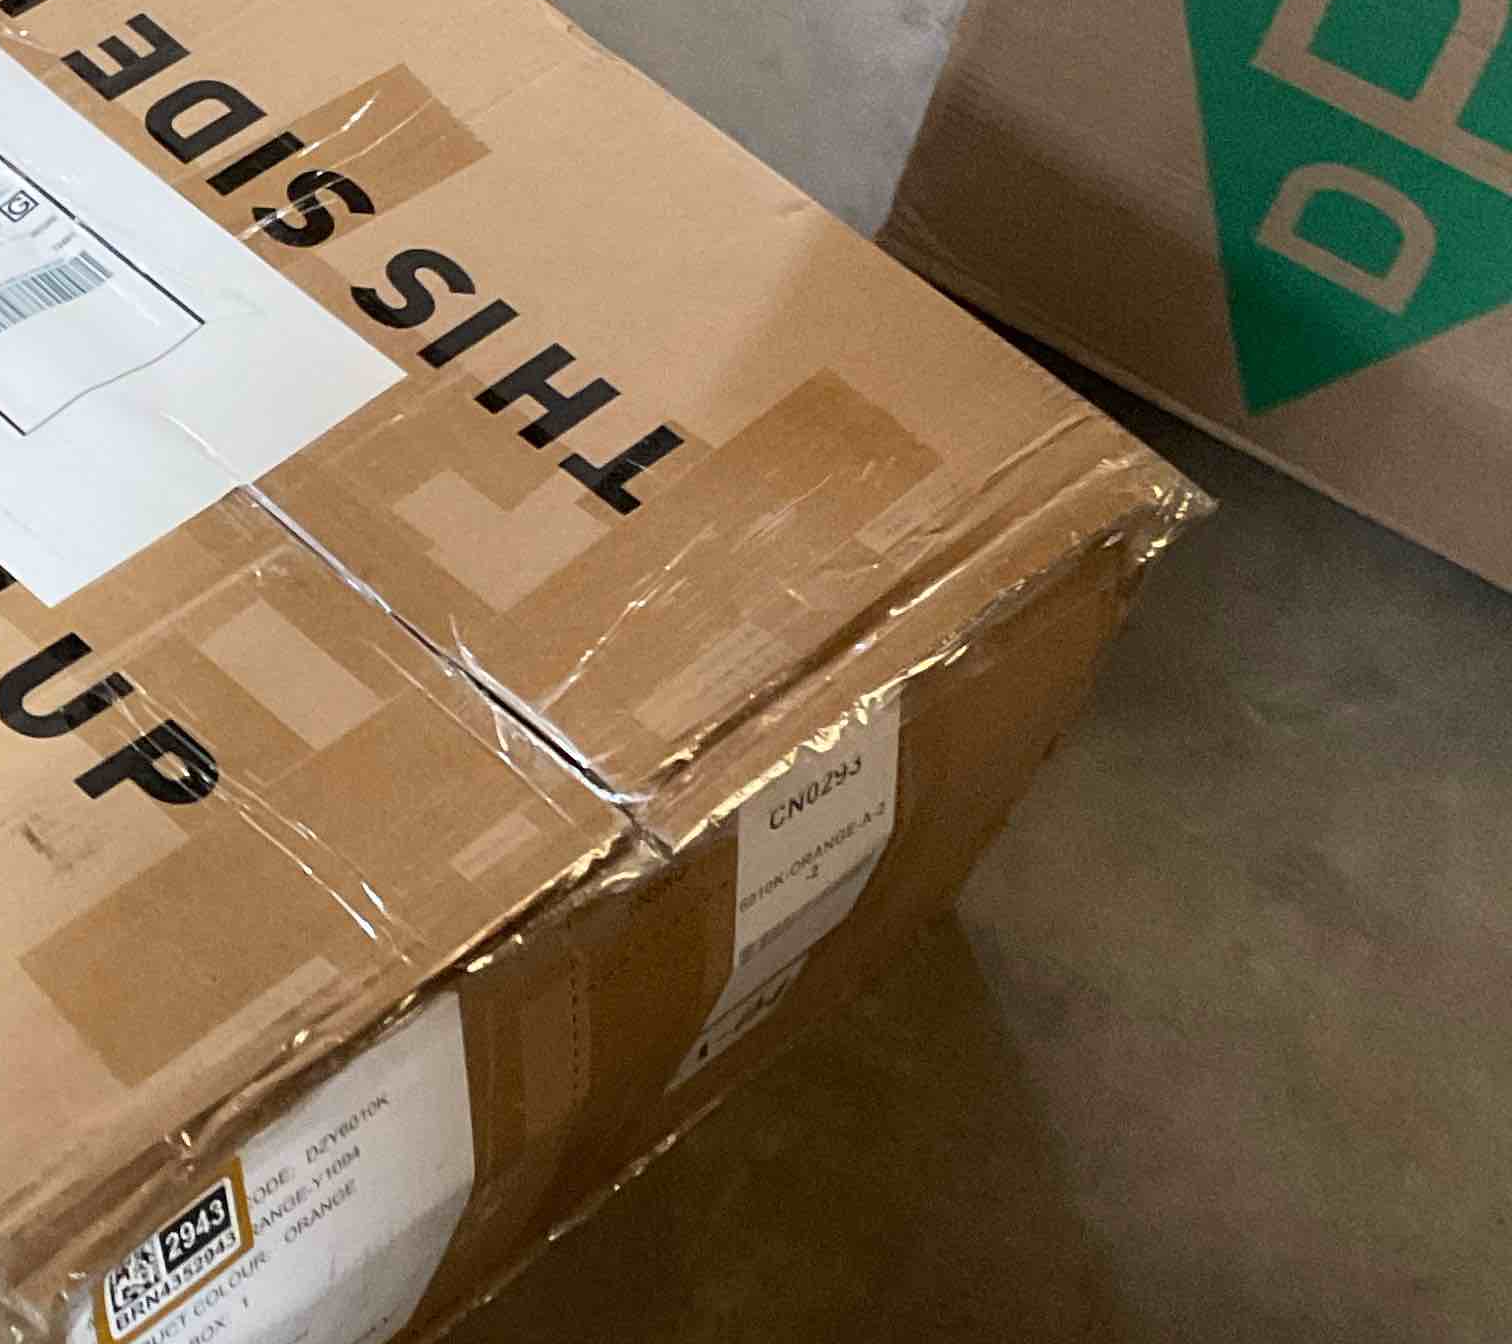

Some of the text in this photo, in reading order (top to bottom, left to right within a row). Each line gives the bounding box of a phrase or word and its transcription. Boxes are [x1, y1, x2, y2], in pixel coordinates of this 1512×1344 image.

[60, 12, 375, 248] SIDE
[351, 249, 685, 516] THIS
[769, 756, 862, 830] CN0293
[165, 1199, 226, 1262] 2943
[284, 1178, 356, 1244] ORANGE
